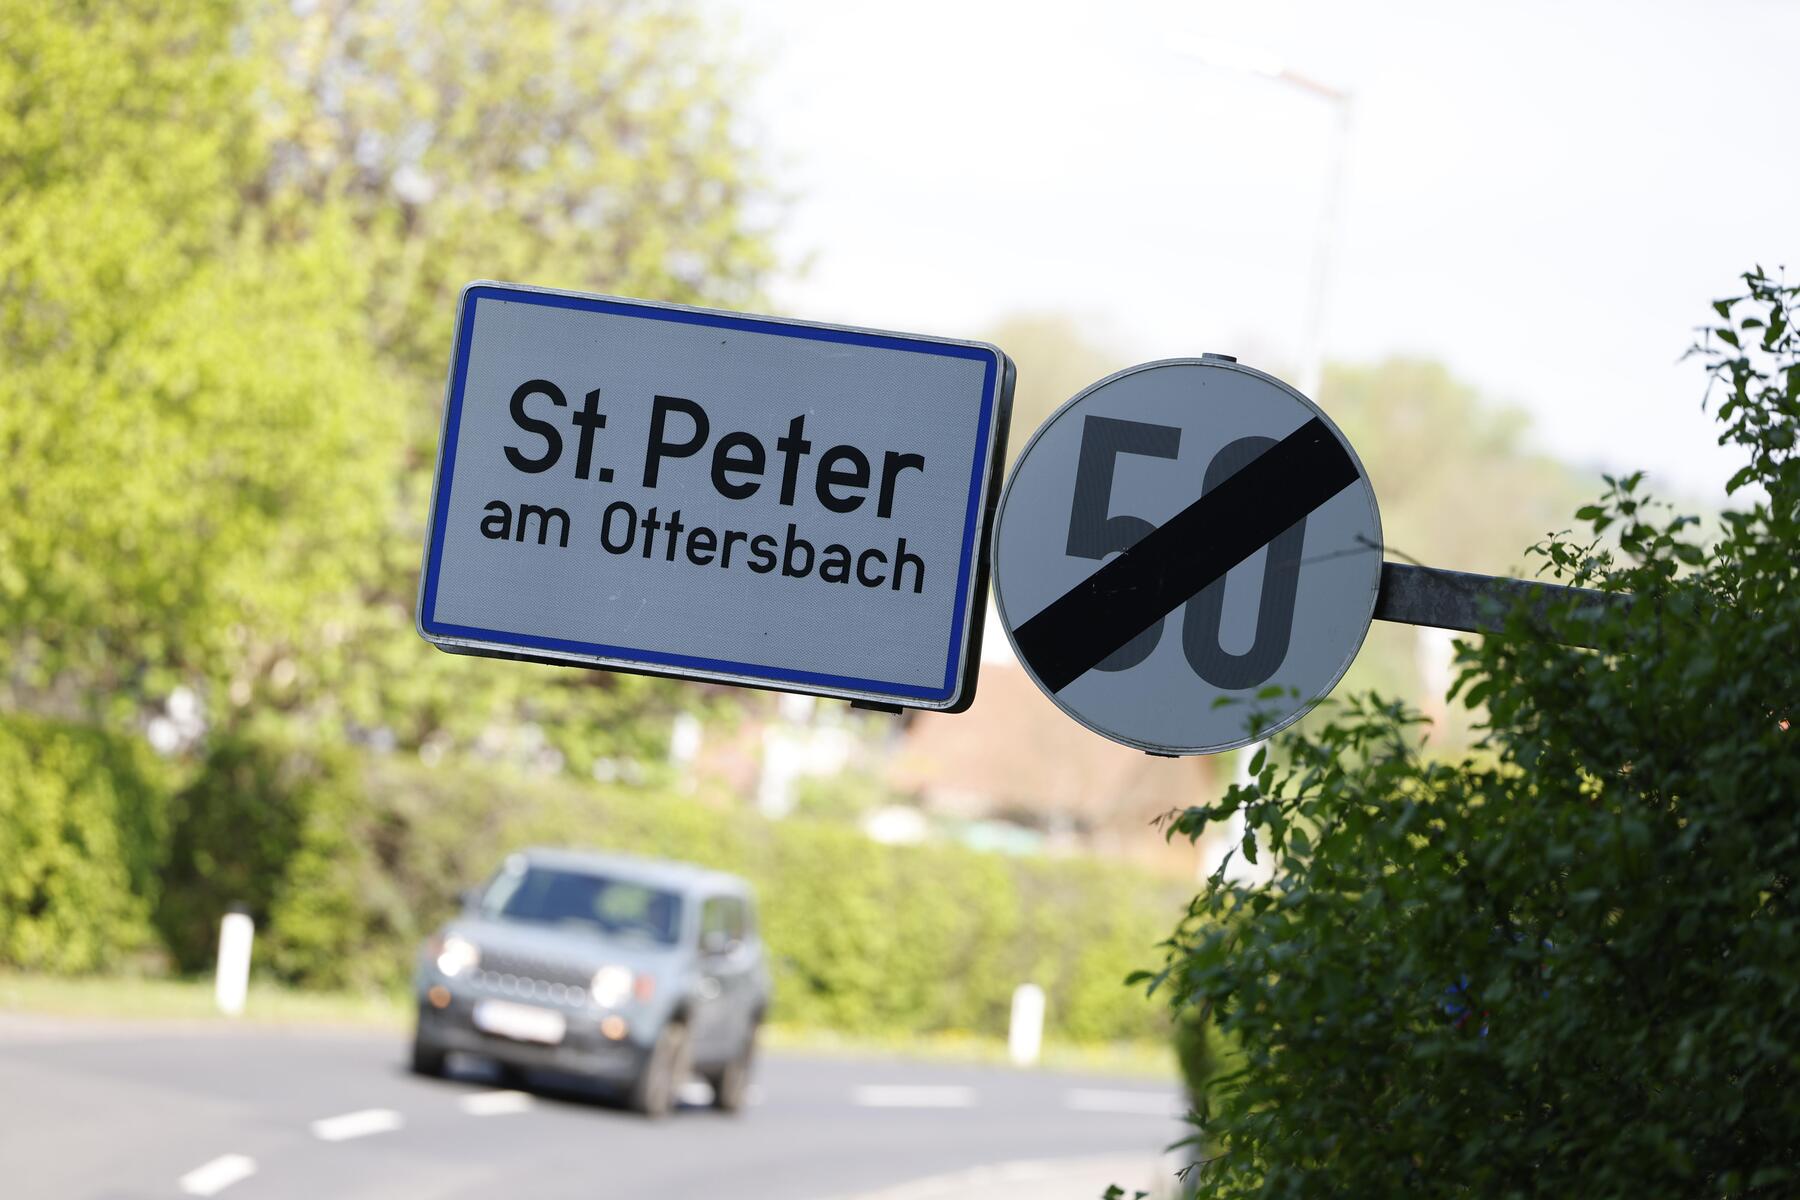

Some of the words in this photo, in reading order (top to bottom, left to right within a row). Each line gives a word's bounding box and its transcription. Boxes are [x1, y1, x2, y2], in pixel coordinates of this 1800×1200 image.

[503, 378, 615, 484] St.
[641, 394, 926, 520] Peter
[479, 499, 571, 548] am
[600, 500, 926, 595] Ottersbach
[1065, 414, 1309, 691] 50
